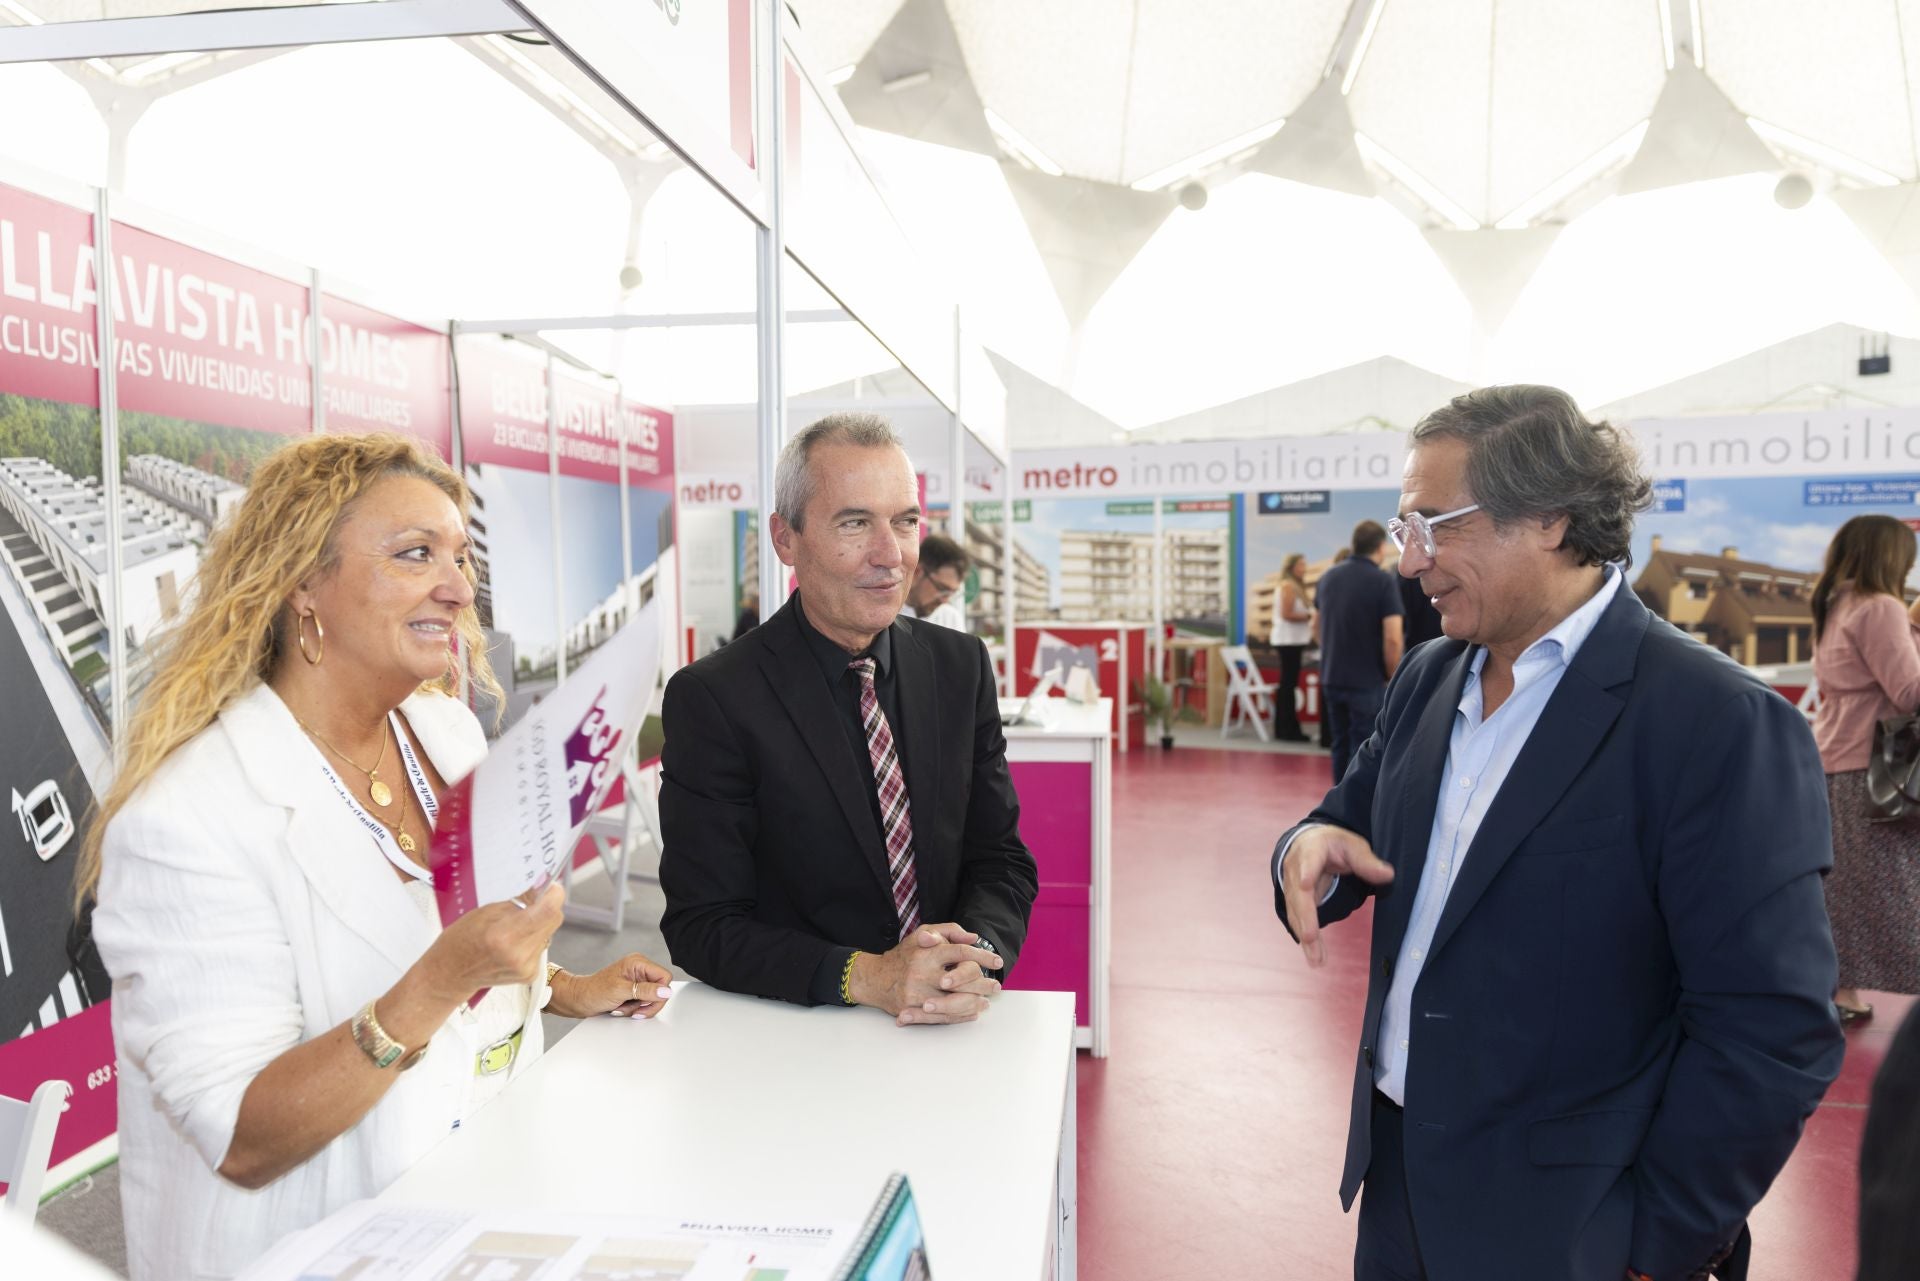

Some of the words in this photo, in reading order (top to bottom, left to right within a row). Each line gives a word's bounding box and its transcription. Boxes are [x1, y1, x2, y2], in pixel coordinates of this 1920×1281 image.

[0, 314, 153, 378] CLUSIVAS
[158, 347, 275, 401] VIVIENDAS
[273, 302, 409, 391] HOMES
[1024, 462, 1118, 490] metro
[1131, 443, 1391, 485] inmobiliaria
[404, 743, 421, 777] Castilla
[535, 758, 552, 831] ROYAL
[87, 1064, 112, 1090] 633
[680, 1223, 769, 1234] BELLAVISTA
[775, 1227, 833, 1236] HOMES
